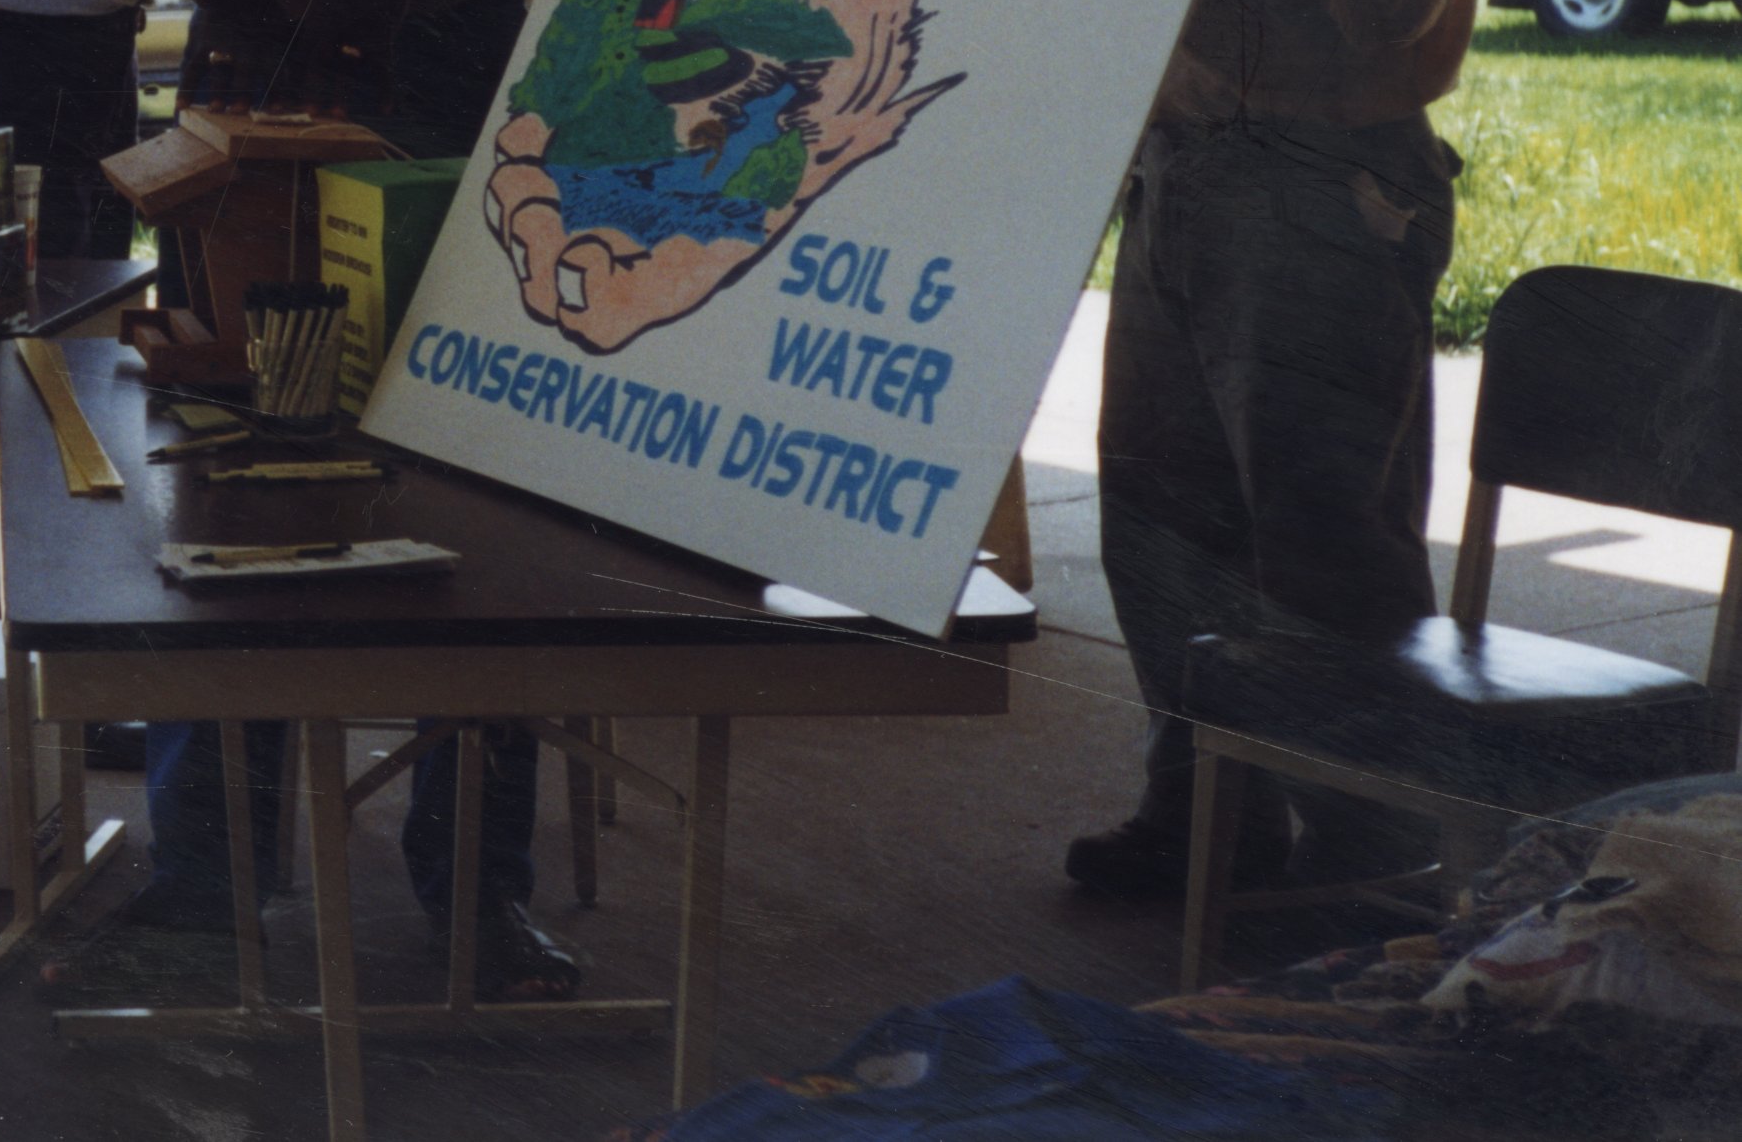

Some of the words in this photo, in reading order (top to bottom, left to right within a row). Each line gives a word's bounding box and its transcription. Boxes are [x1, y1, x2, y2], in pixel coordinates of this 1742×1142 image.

[778, 232, 891, 316] SOIL
[907, 255, 958, 325] &
[767, 316, 956, 426] WATER
[406, 323, 723, 469] CONSERVATION
[717, 413, 962, 540] DISTRICT
